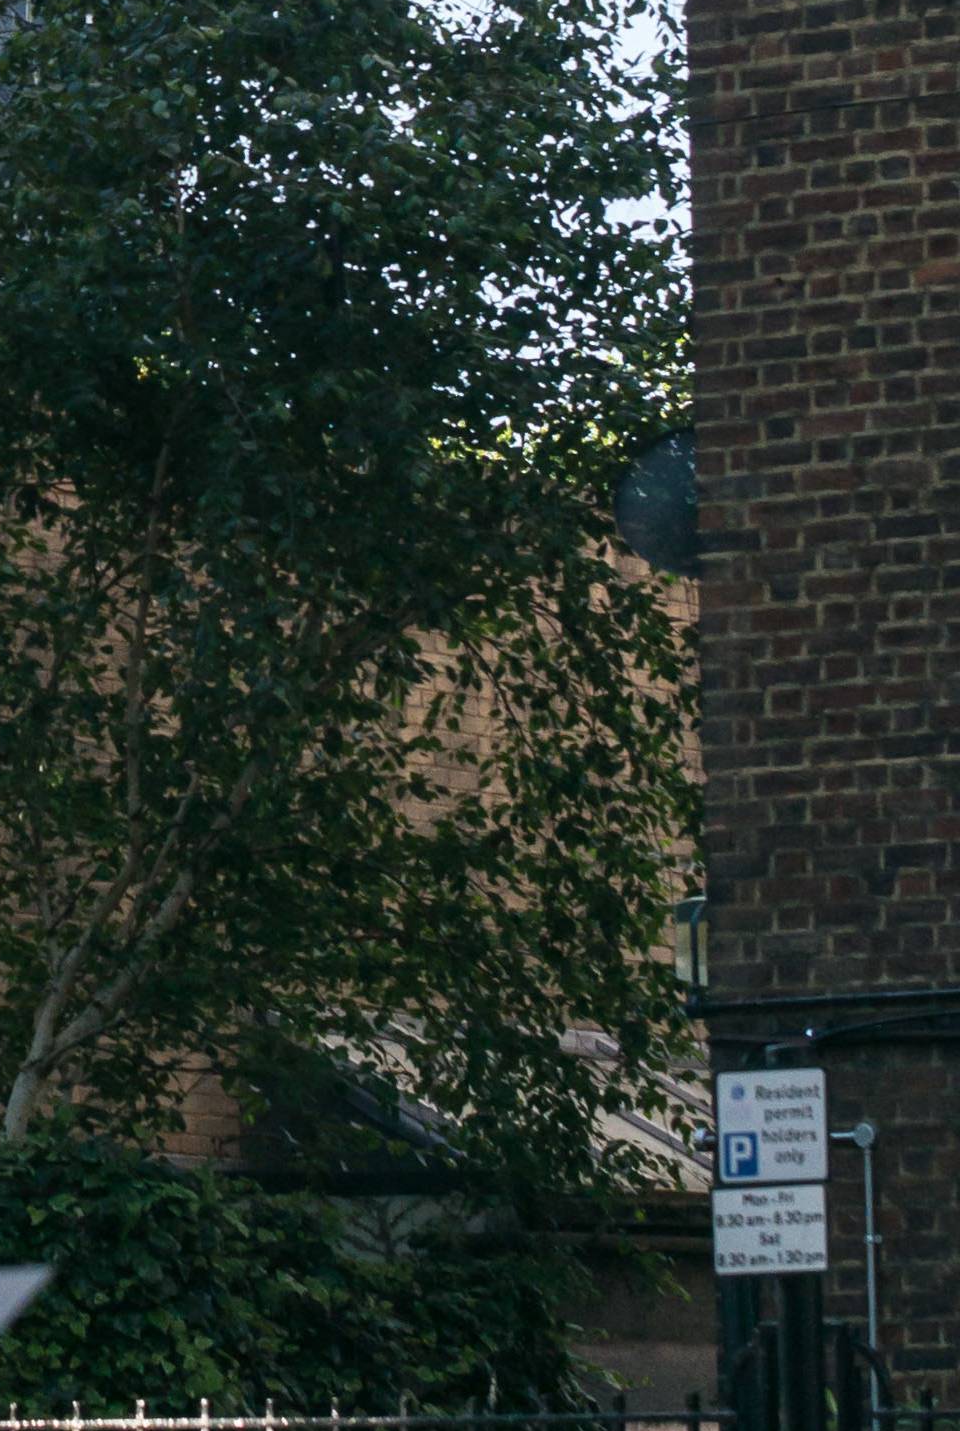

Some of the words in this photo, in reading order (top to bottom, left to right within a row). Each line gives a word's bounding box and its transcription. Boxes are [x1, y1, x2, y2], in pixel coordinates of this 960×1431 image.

[756, 1085, 820, 1099] Resident
[764, 1106, 814, 1123] permit
[761, 1129, 817, 1143] holders
[729, 1136, 752, 1174] P
[775, 1149, 804, 1165] only
[742, 1194, 768, 1206] Mon
[759, 1232, 780, 1246] Sat
